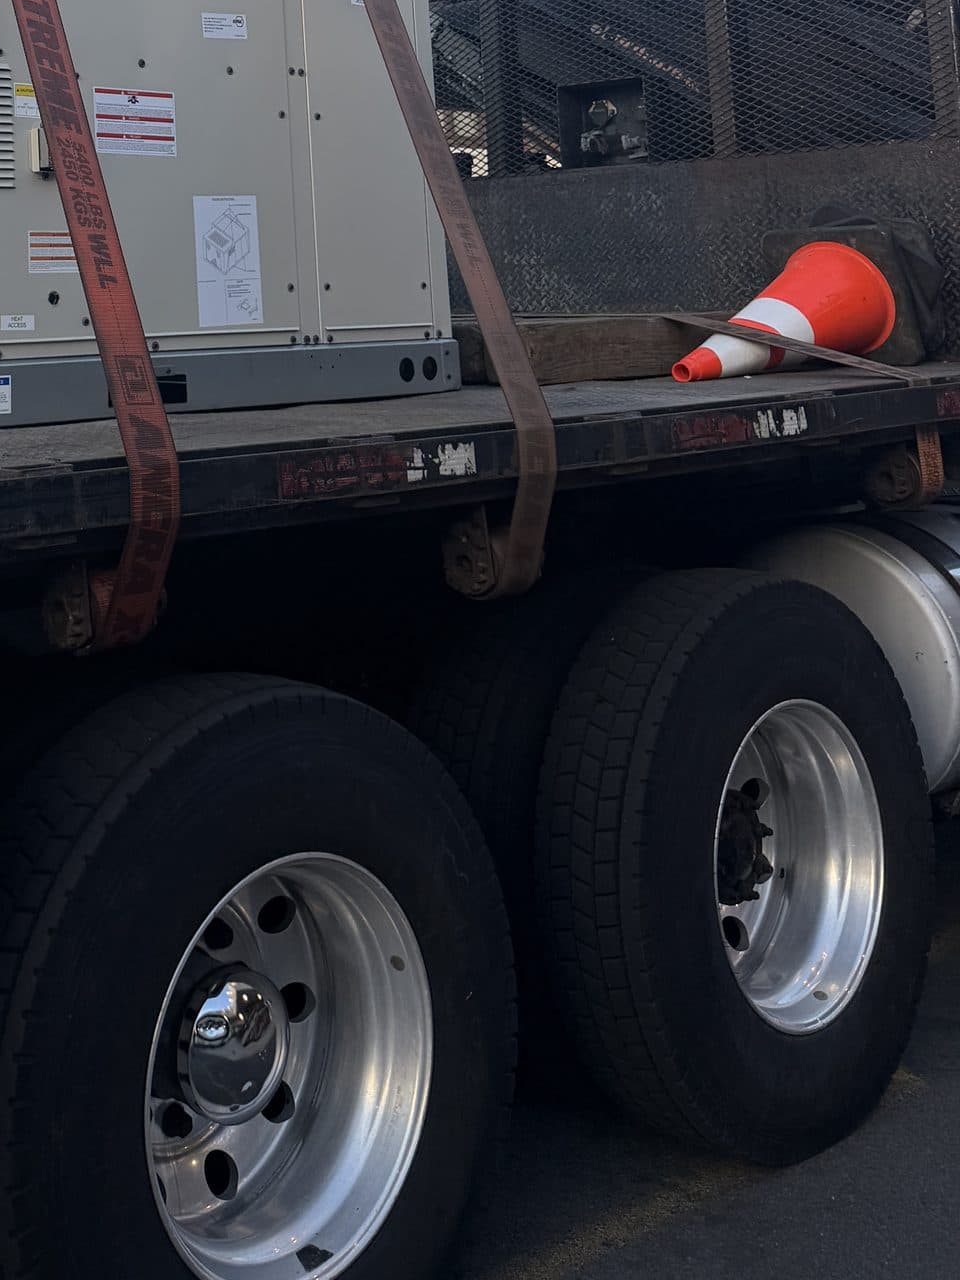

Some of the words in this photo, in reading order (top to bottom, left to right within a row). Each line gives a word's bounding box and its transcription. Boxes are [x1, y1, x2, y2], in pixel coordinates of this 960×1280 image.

[56, 135, 78, 184] 2450
[70, 184, 92, 228] KGS
[73, 140, 95, 187] 5400
[86, 189, 107, 231] LBS
[87, 230, 118, 289] WLL
